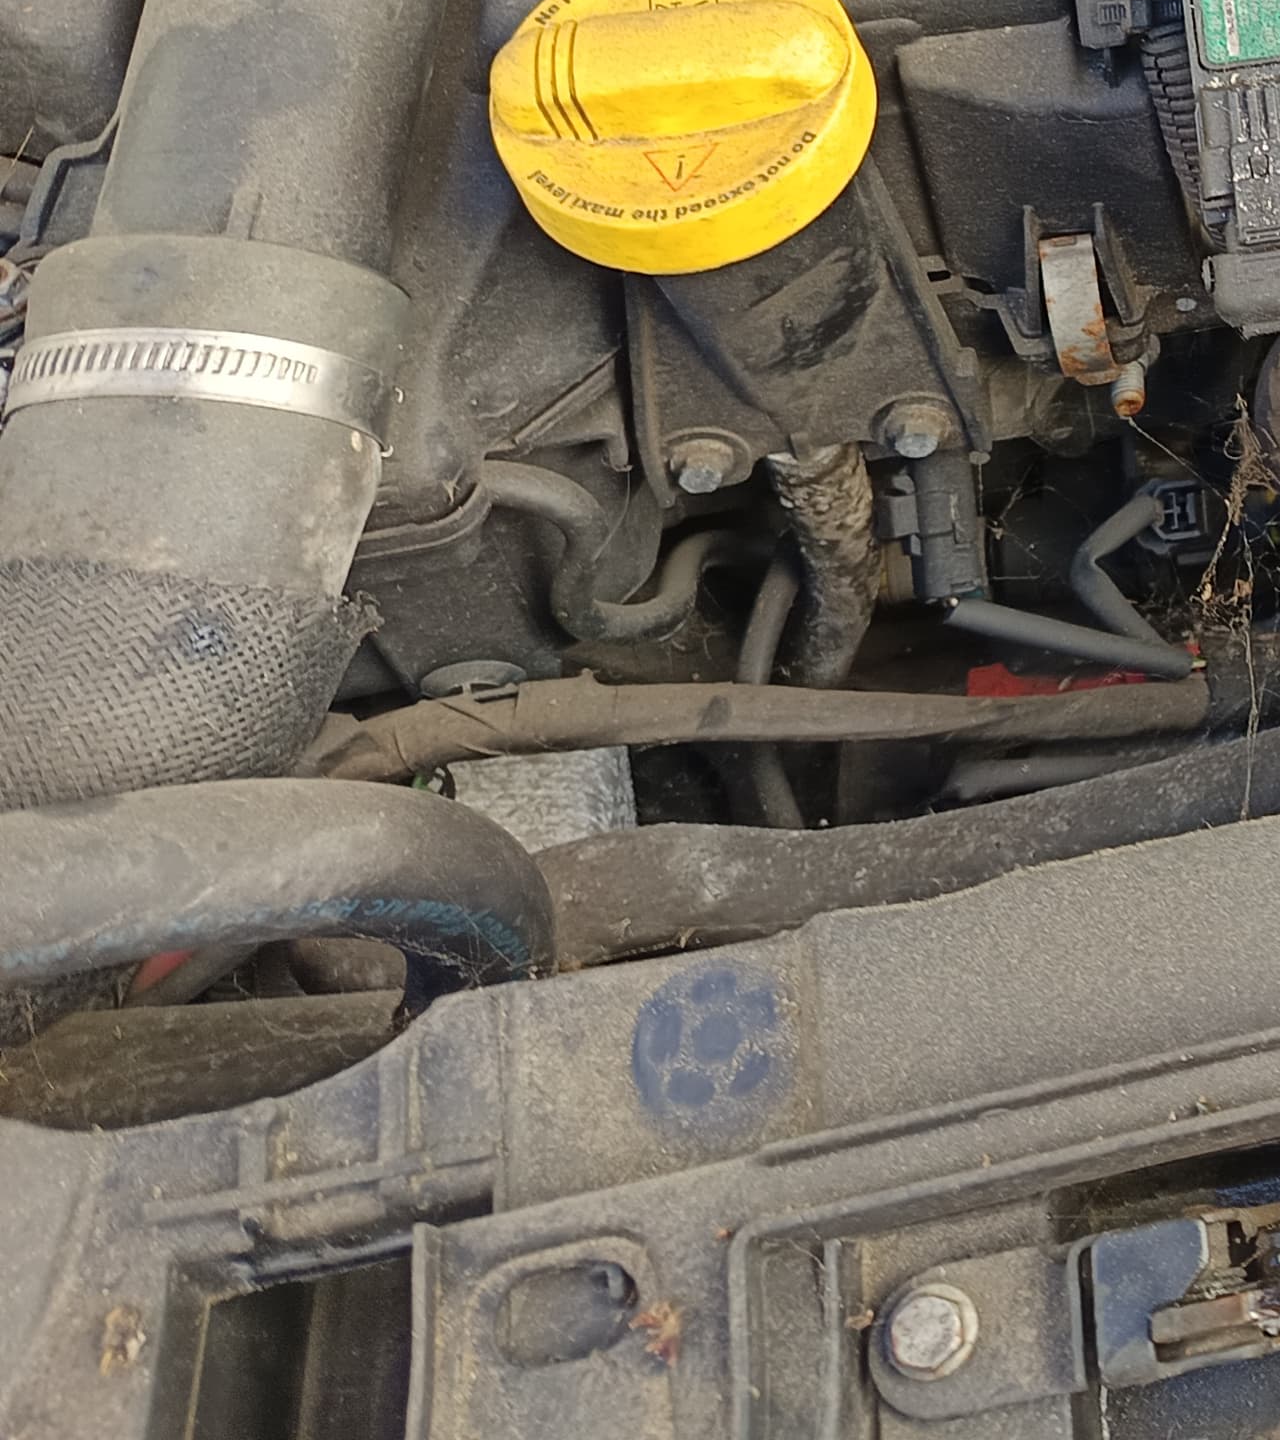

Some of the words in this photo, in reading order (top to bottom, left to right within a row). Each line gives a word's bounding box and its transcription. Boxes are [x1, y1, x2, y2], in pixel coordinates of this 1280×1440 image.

[792, 130, 817, 154] Do
[757, 155, 789, 183] not
[526, 169, 573, 206] level
[675, 177, 757, 220] exceed
[571, 196, 625, 220] maxi
[632, 208, 670, 223] the
